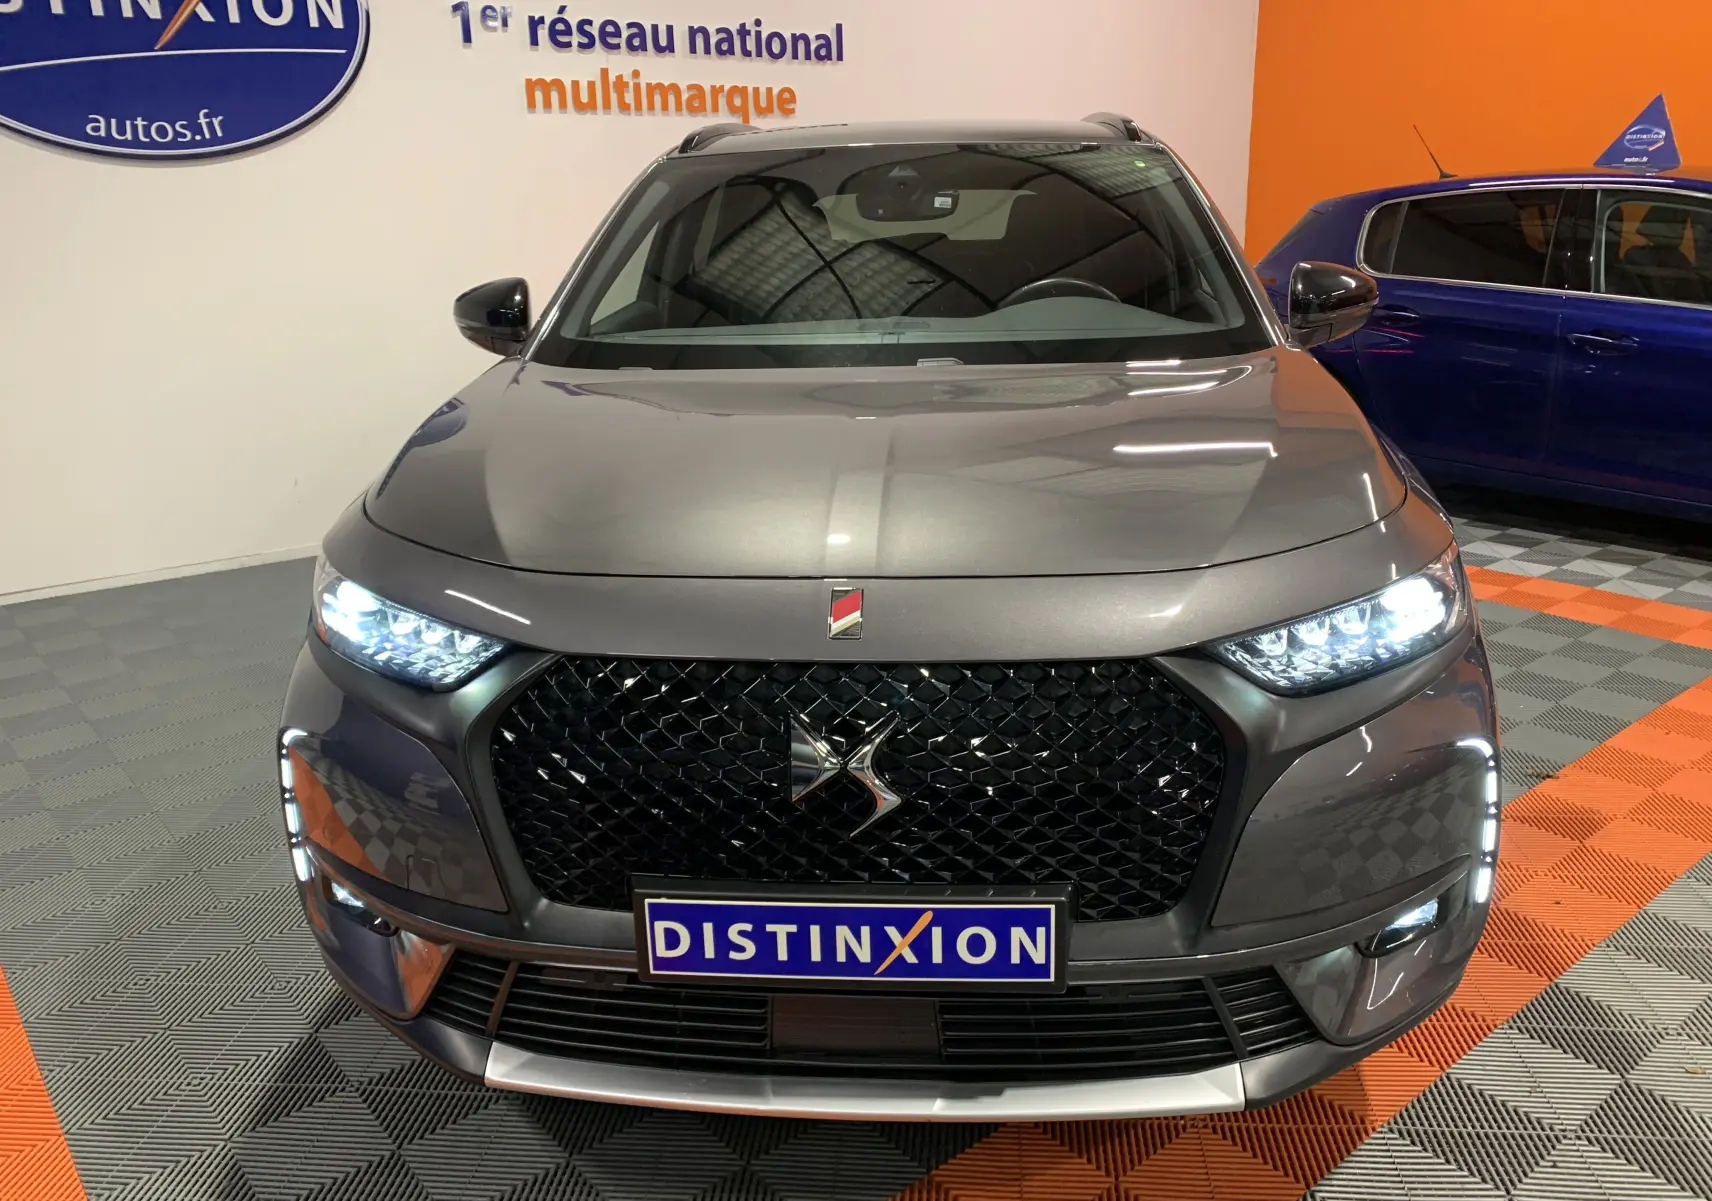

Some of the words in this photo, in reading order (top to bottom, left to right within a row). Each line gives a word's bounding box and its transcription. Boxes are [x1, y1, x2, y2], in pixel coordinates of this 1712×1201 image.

[527, 5, 675, 54] réseau
[688, 18, 844, 62] national
[525, 67, 797, 124] multimarque
[85, 109, 225, 142] autos.fr
[653, 911, 1047, 976] DISTINXION
